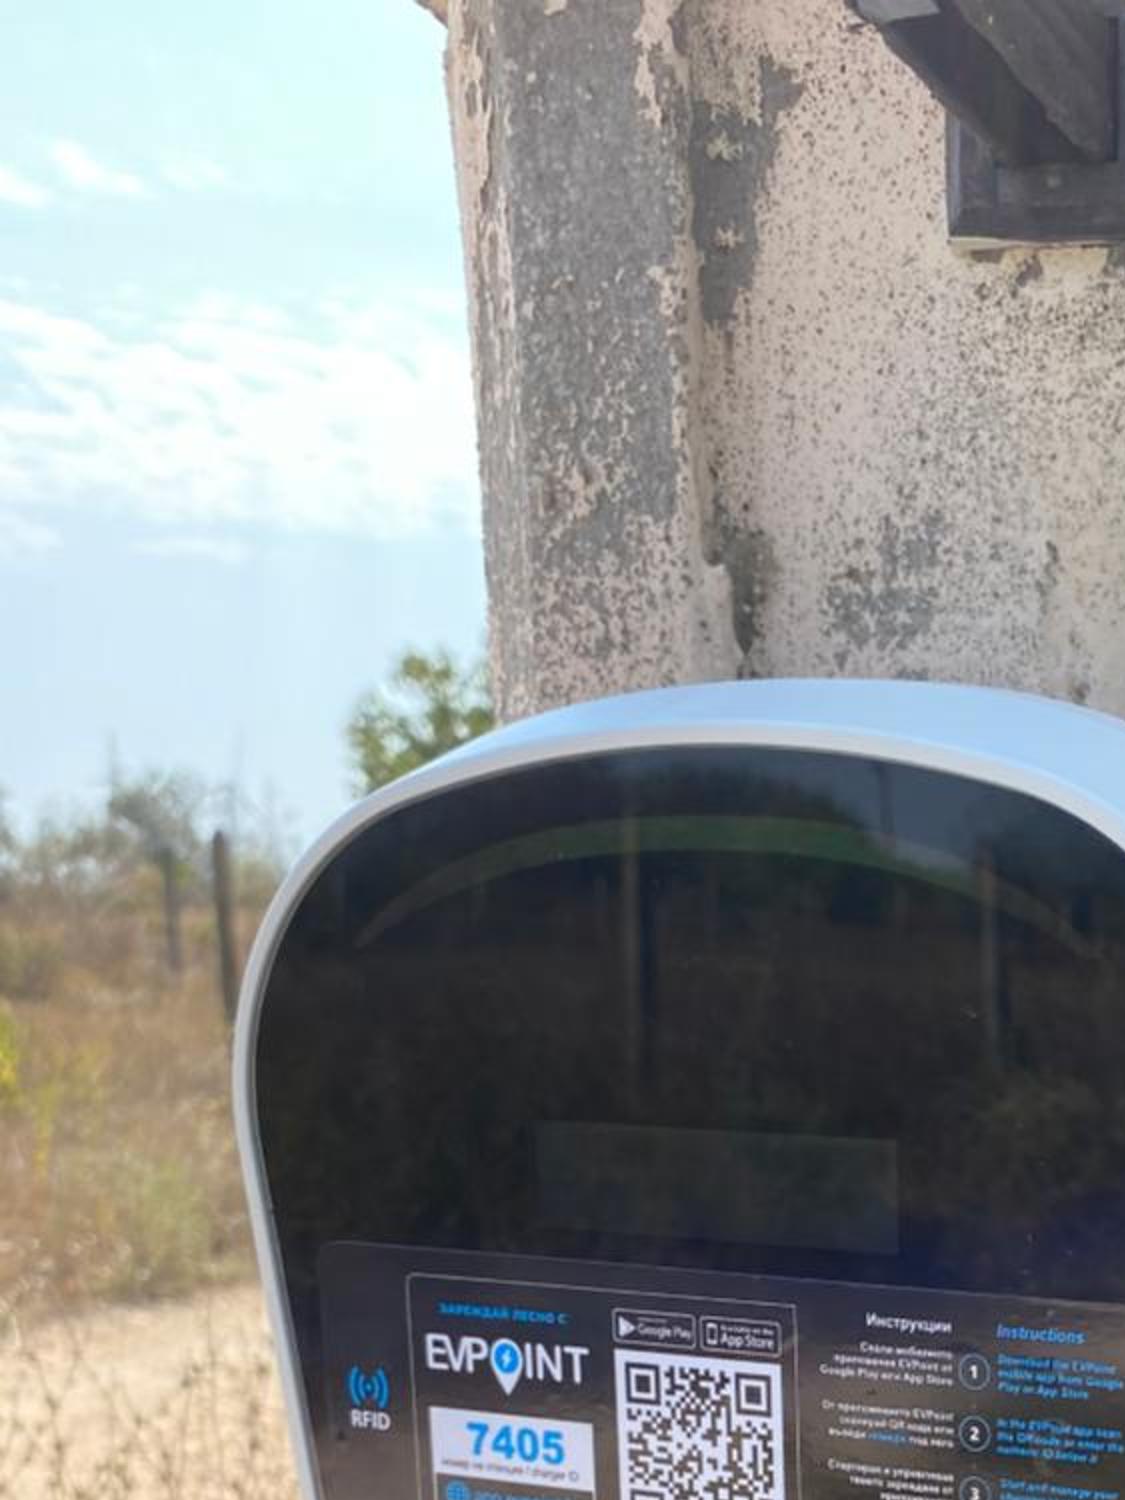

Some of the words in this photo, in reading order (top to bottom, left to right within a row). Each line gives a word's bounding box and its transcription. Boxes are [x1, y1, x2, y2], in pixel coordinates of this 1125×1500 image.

[638, 1322, 671, 1340] Google
[673, 1324, 691, 1341] Play
[865, 1312, 952, 1334] Инструкции
[720, 1332, 743, 1347] App
[745, 1334, 774, 1351] Store
[996, 1323, 1087, 1345] Instructions
[425, 1333, 590, 1394] EVPOINT
[819, 1363, 855, 1378] Google
[970, 1364, 978, 1379] 1
[350, 1409, 391, 1431] RFID
[466, 1420, 565, 1465] 7405
[970, 1426, 979, 1442] 2
